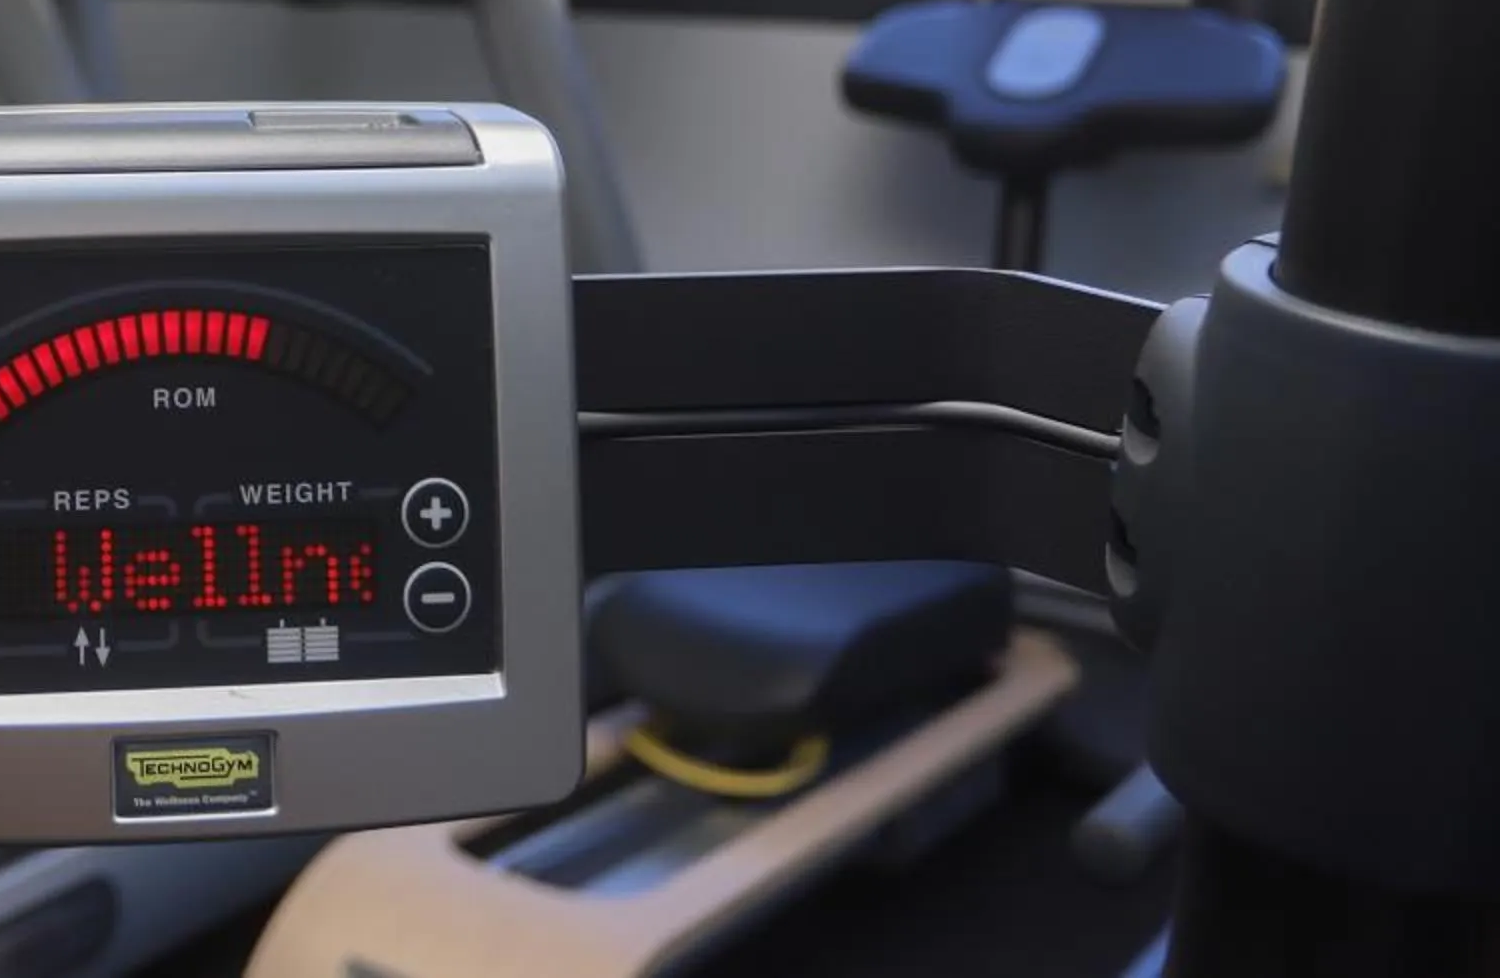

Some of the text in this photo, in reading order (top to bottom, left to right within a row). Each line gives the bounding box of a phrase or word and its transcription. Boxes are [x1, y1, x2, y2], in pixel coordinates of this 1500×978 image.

[152, 387, 217, 409] ROM
[53, 489, 131, 512] REPS
[239, 481, 353, 505] WEIGHT
[133, 797, 152, 807] The
